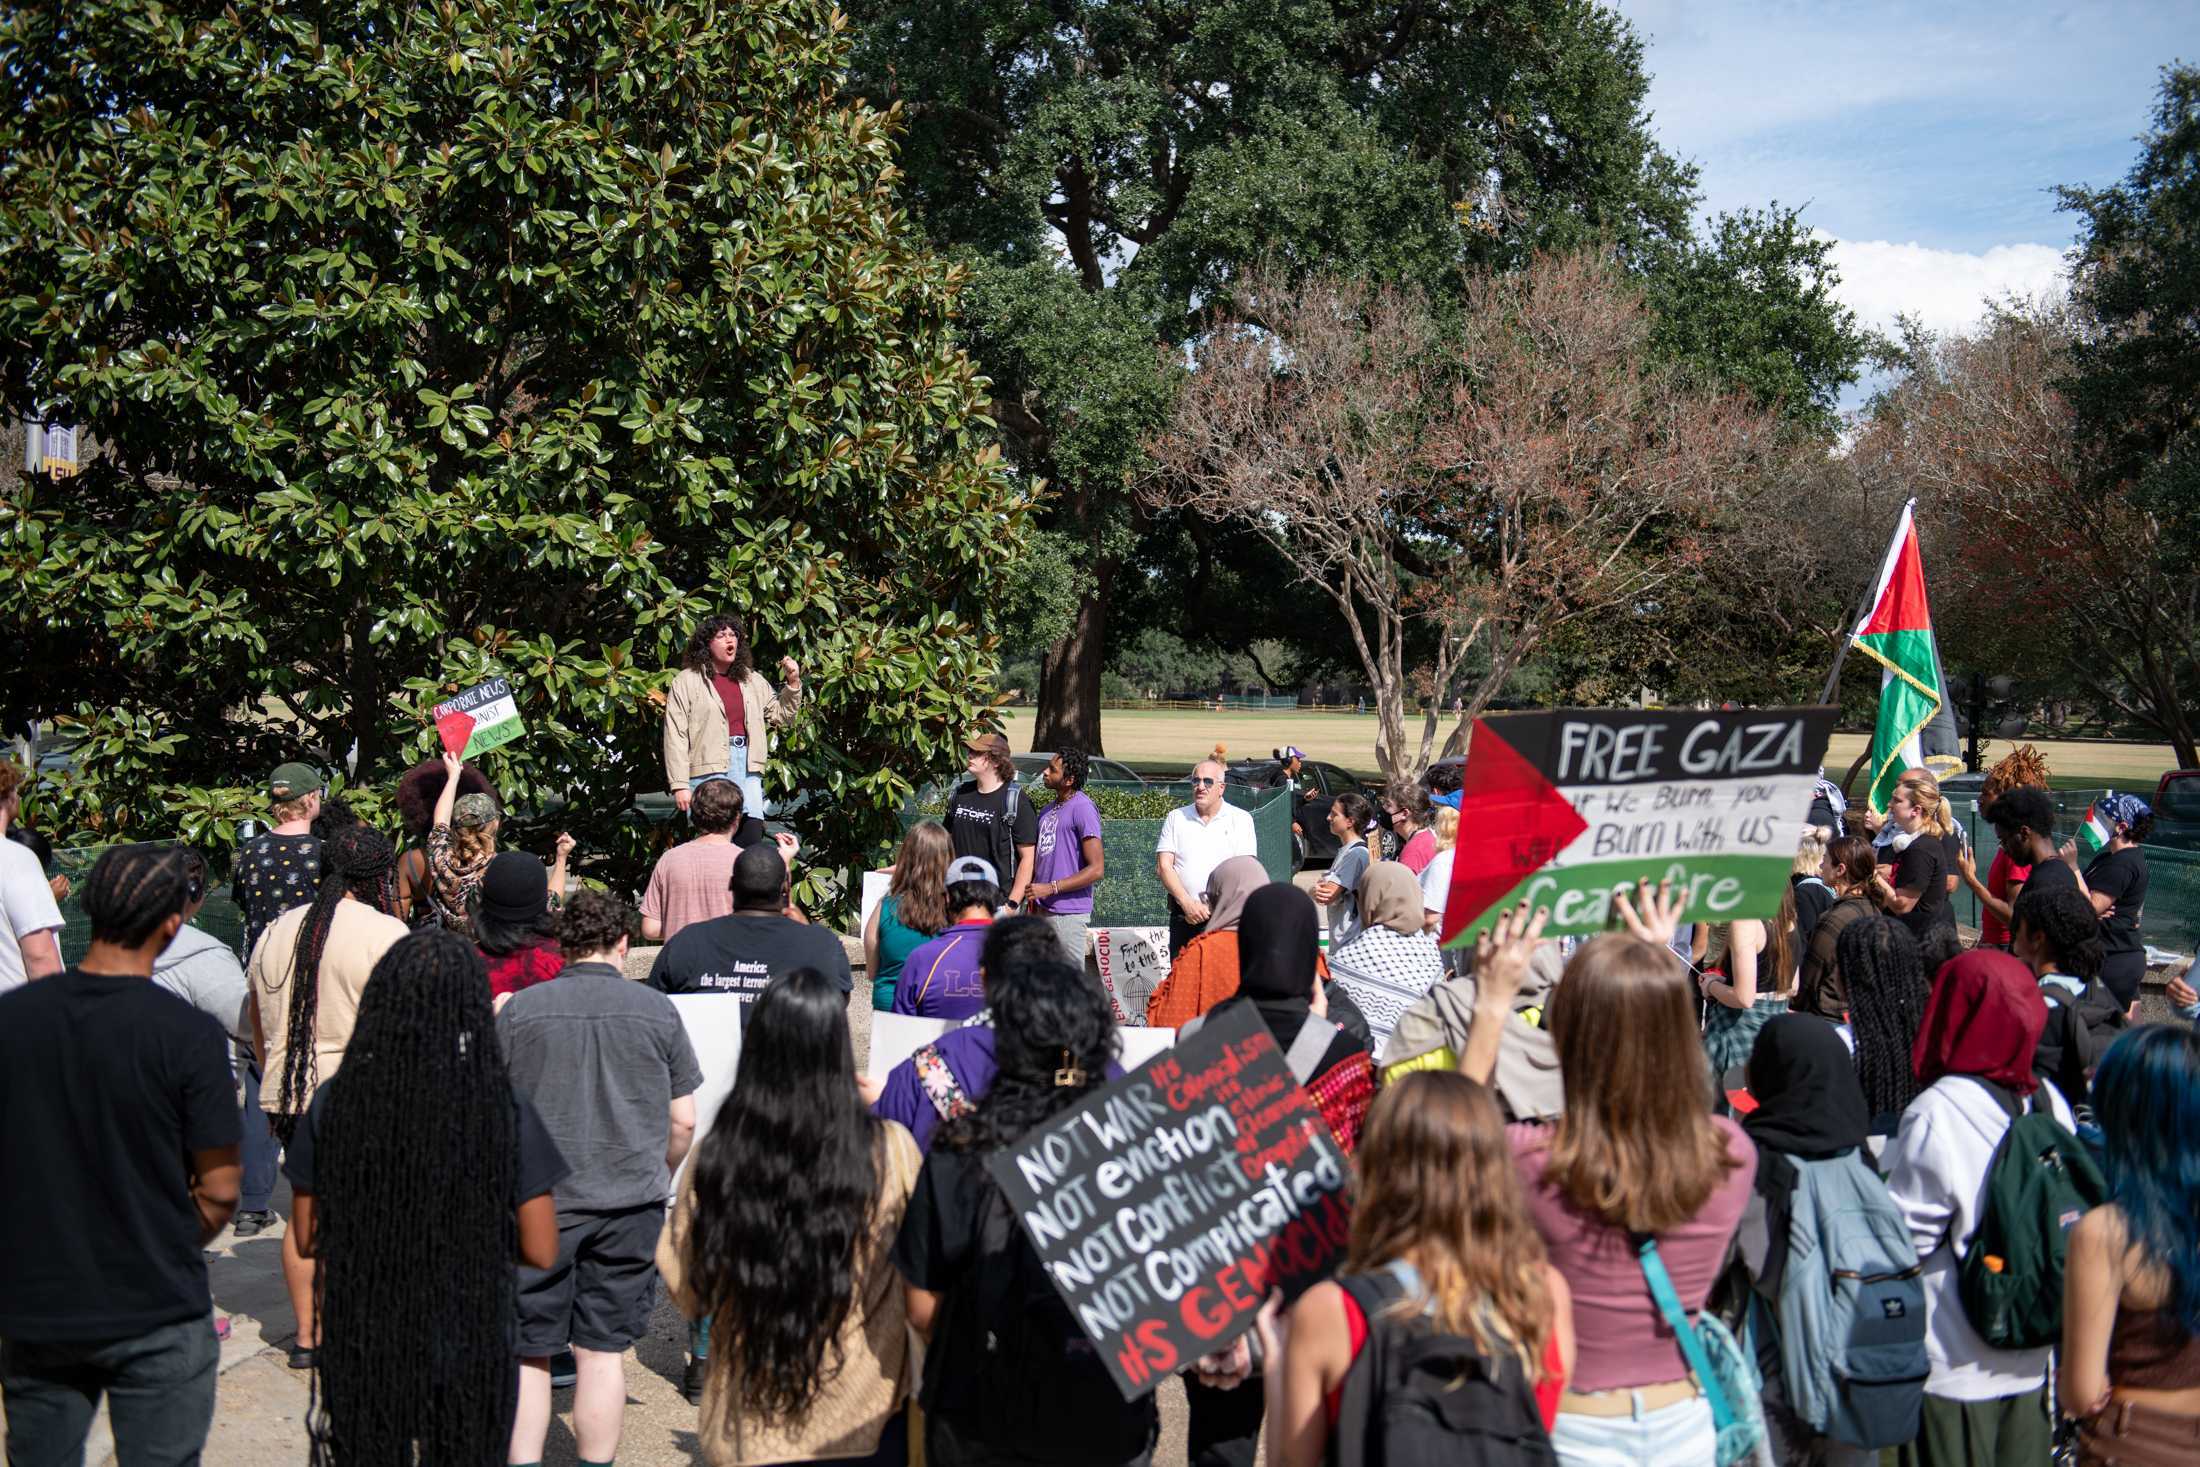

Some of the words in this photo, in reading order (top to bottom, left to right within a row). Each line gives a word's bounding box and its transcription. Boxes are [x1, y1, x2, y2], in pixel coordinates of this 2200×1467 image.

[433, 693, 479, 720] CORPORATE
[480, 679, 505, 701] NEWS
[472, 721, 511, 751] NEWS
[1557, 721, 1668, 781] FREE
[1680, 719, 1806, 774] GAZA
[1120, 939, 1147, 959] From
[1124, 961, 1136, 973] to
[1138, 951, 1158, 968] the
[700, 973, 713, 987] the
[715, 973, 741, 990] largest
[733, 960, 768, 974] America:
[944, 969, 985, 997] LS
[1111, 997, 1126, 1021] END
[1016, 1116, 1091, 1194] NOT
[1081, 1083, 1167, 1150] WAR
[1024, 1174, 1097, 1250] NOT
[1052, 1221, 1126, 1293] NOT
[1078, 1264, 1149, 1341] NOT
